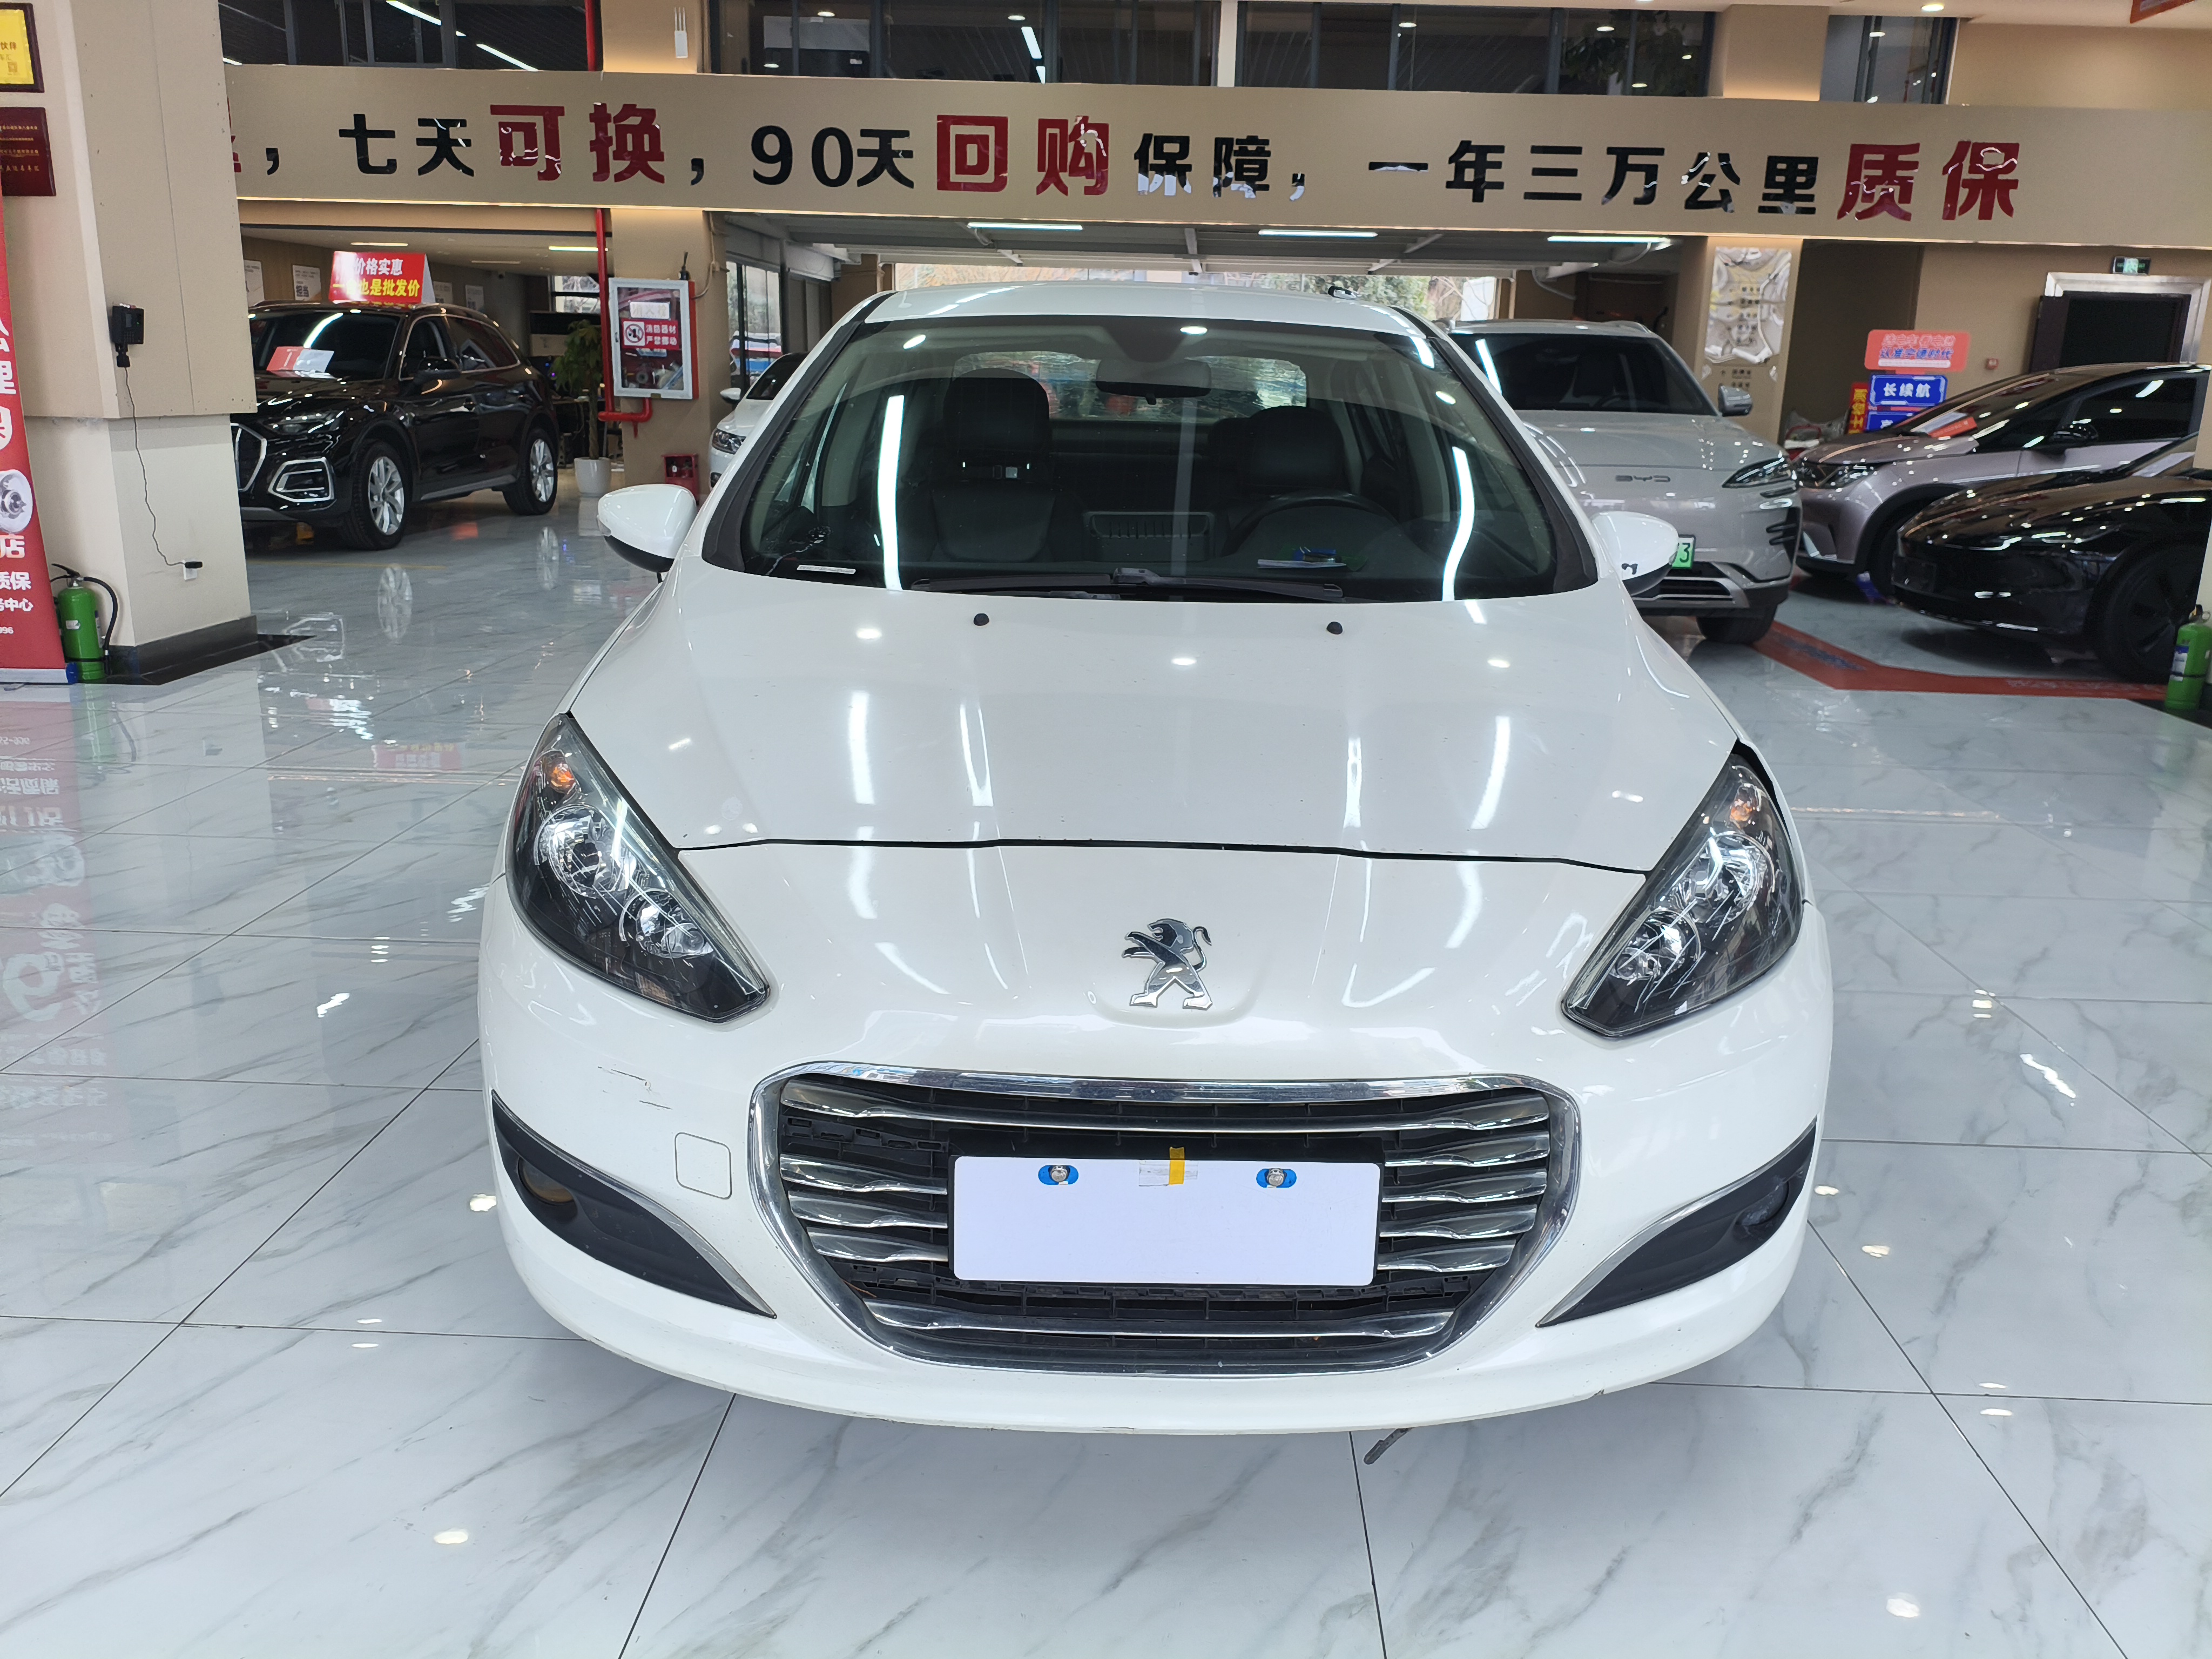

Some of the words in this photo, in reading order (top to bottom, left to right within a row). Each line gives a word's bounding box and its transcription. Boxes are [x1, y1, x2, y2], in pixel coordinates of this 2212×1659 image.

[1883, 382, 1931, 397] 长续航
[0, 597, 33, 612] 中心
